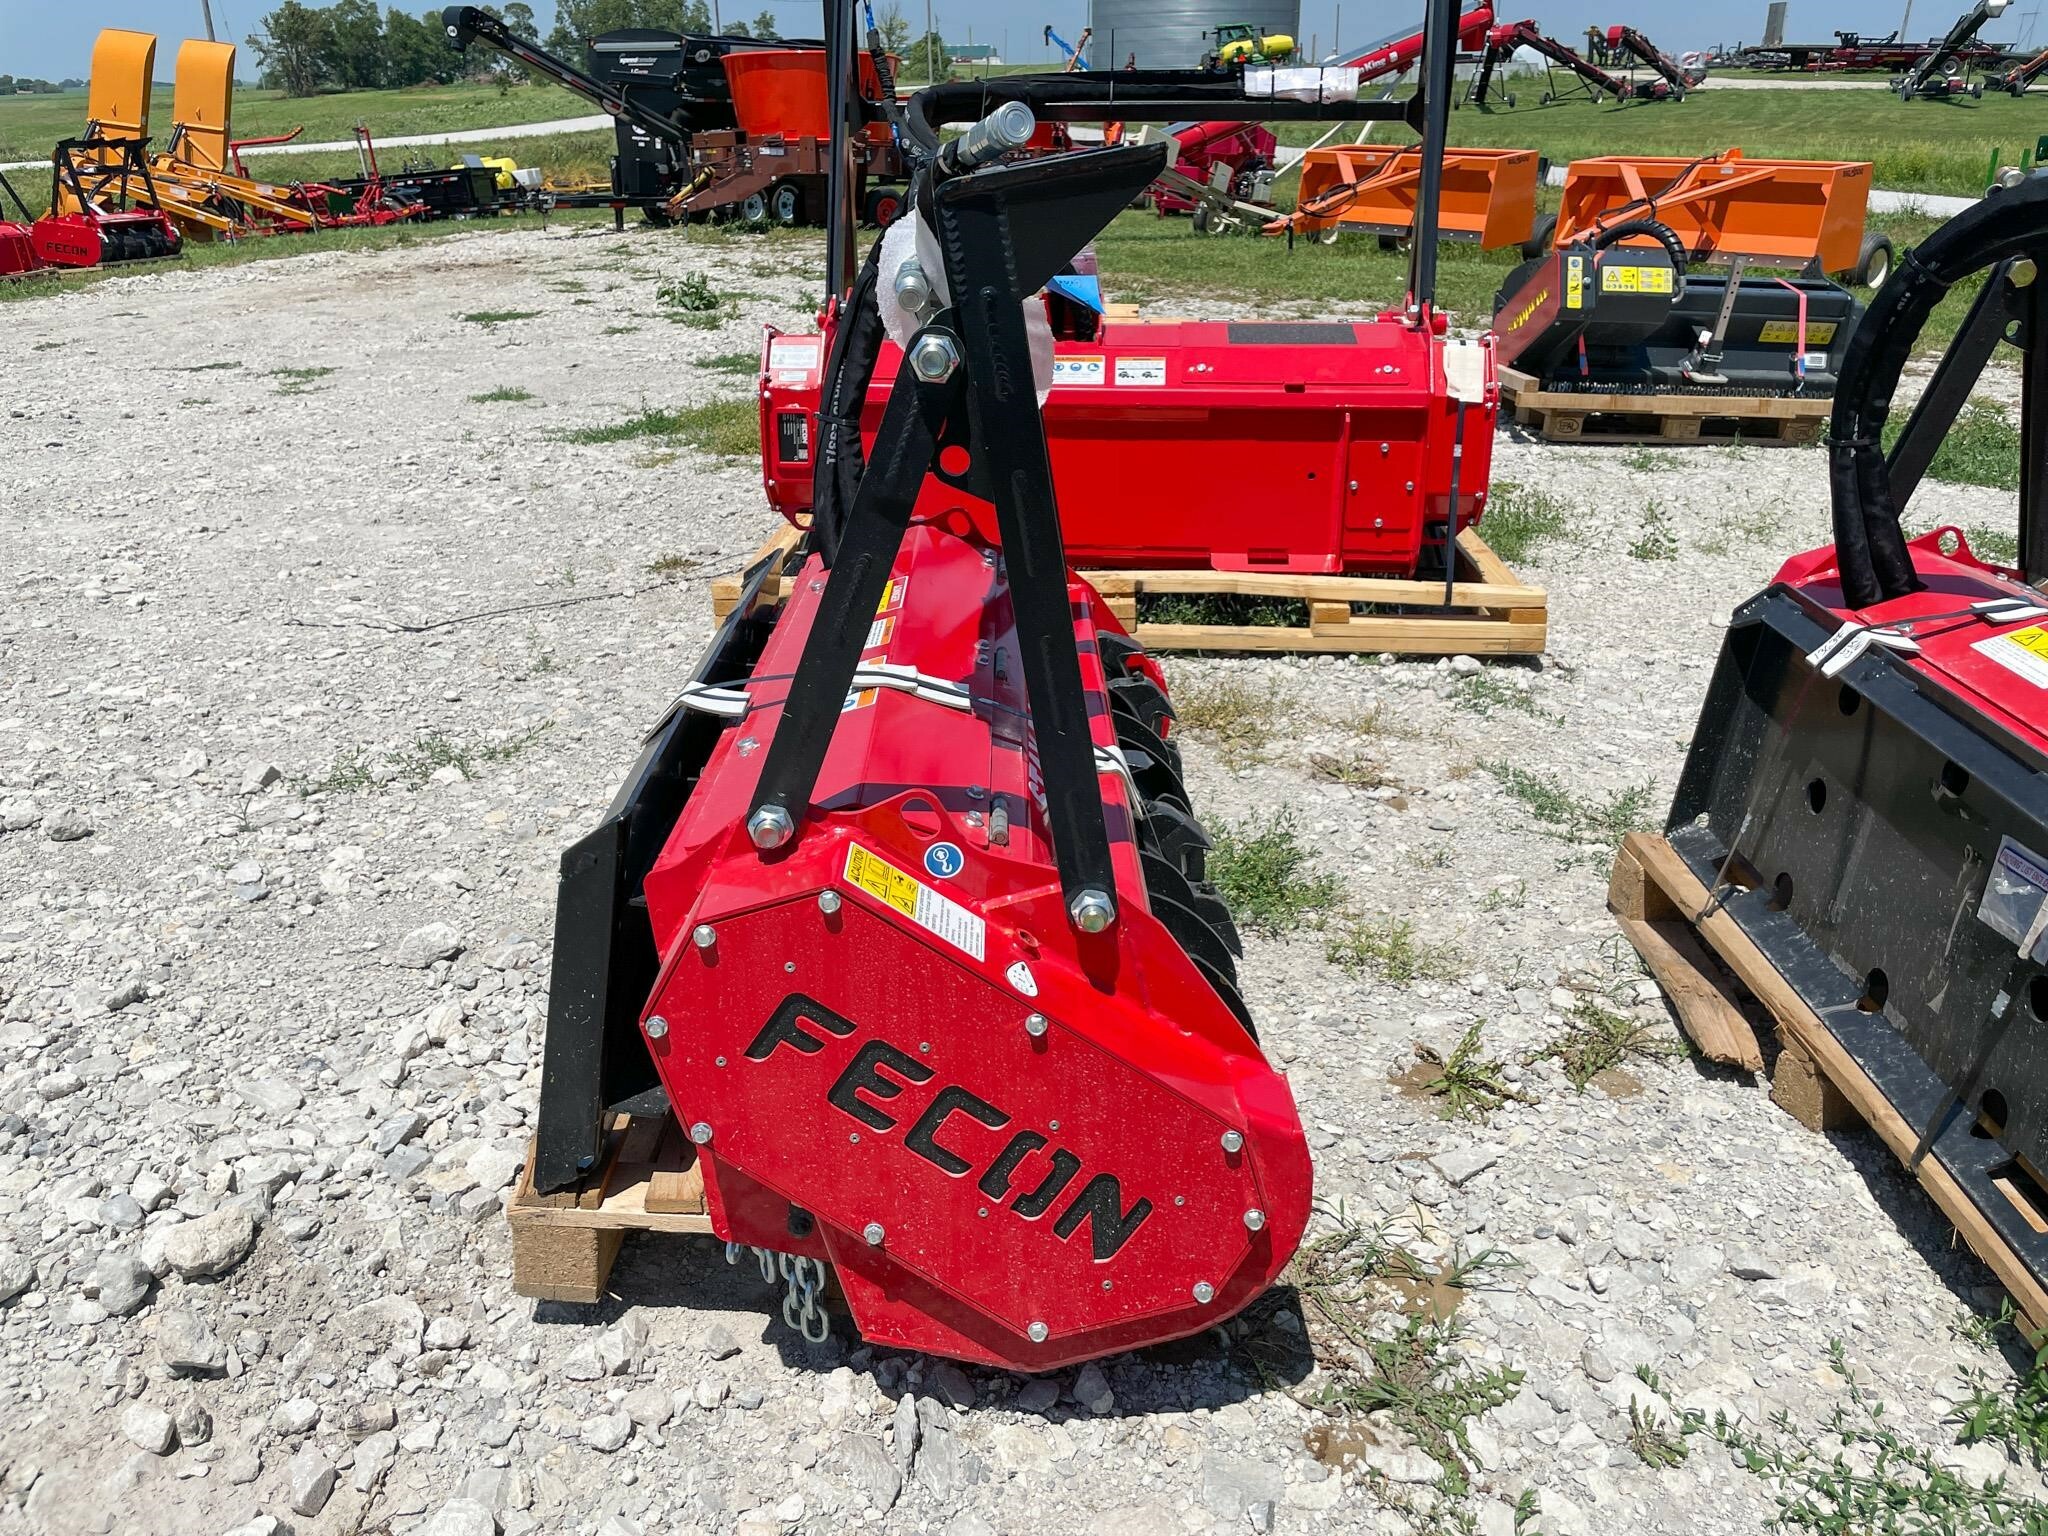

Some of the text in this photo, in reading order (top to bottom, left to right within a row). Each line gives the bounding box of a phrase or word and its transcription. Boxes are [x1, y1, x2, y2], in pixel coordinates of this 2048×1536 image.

[46, 242, 88, 256] FECON
[851, 849, 865, 875] CAUTION
[743, 992, 1153, 1264] FECON
